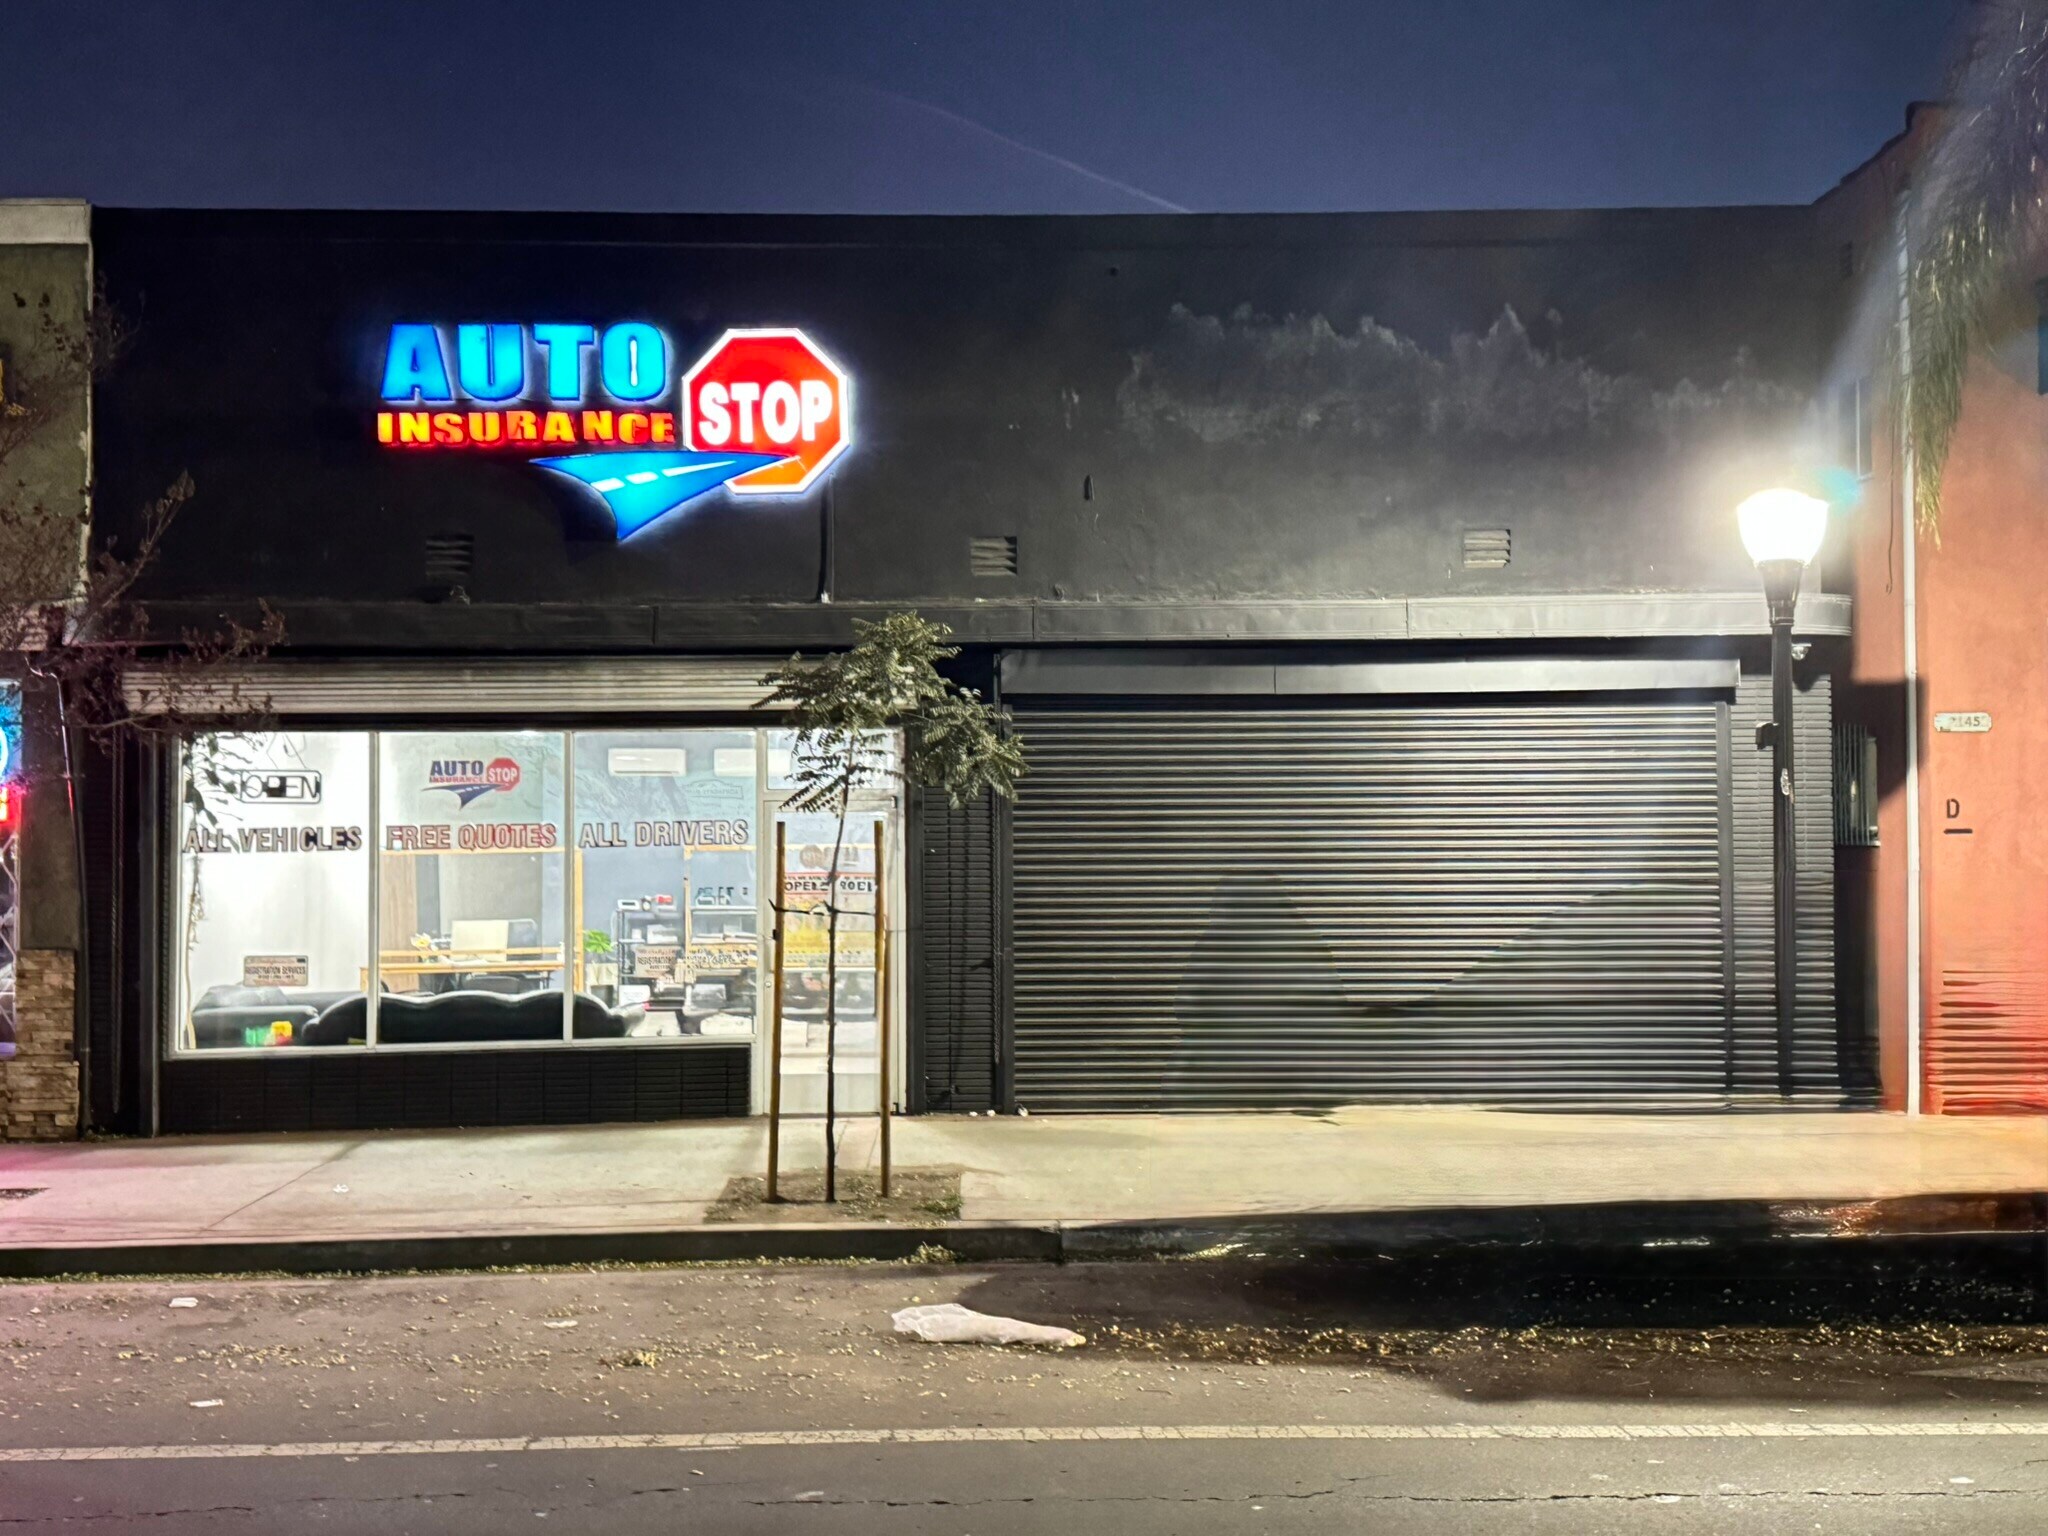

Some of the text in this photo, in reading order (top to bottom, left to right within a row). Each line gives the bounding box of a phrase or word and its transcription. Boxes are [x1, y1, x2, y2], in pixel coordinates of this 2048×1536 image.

[381, 322, 666, 400] AUTO
[699, 380, 833, 445] STOP
[377, 410, 676, 444] INSURANCE
[430, 760, 484, 776] AUTO
[488, 767, 518, 783] STOP
[245, 775, 319, 799] OPEN
[183, 826, 363, 853] ALL VEHICLES
[385, 823, 557, 851] FREE QUOTES
[578, 819, 749, 848] ALL DRIVERS
